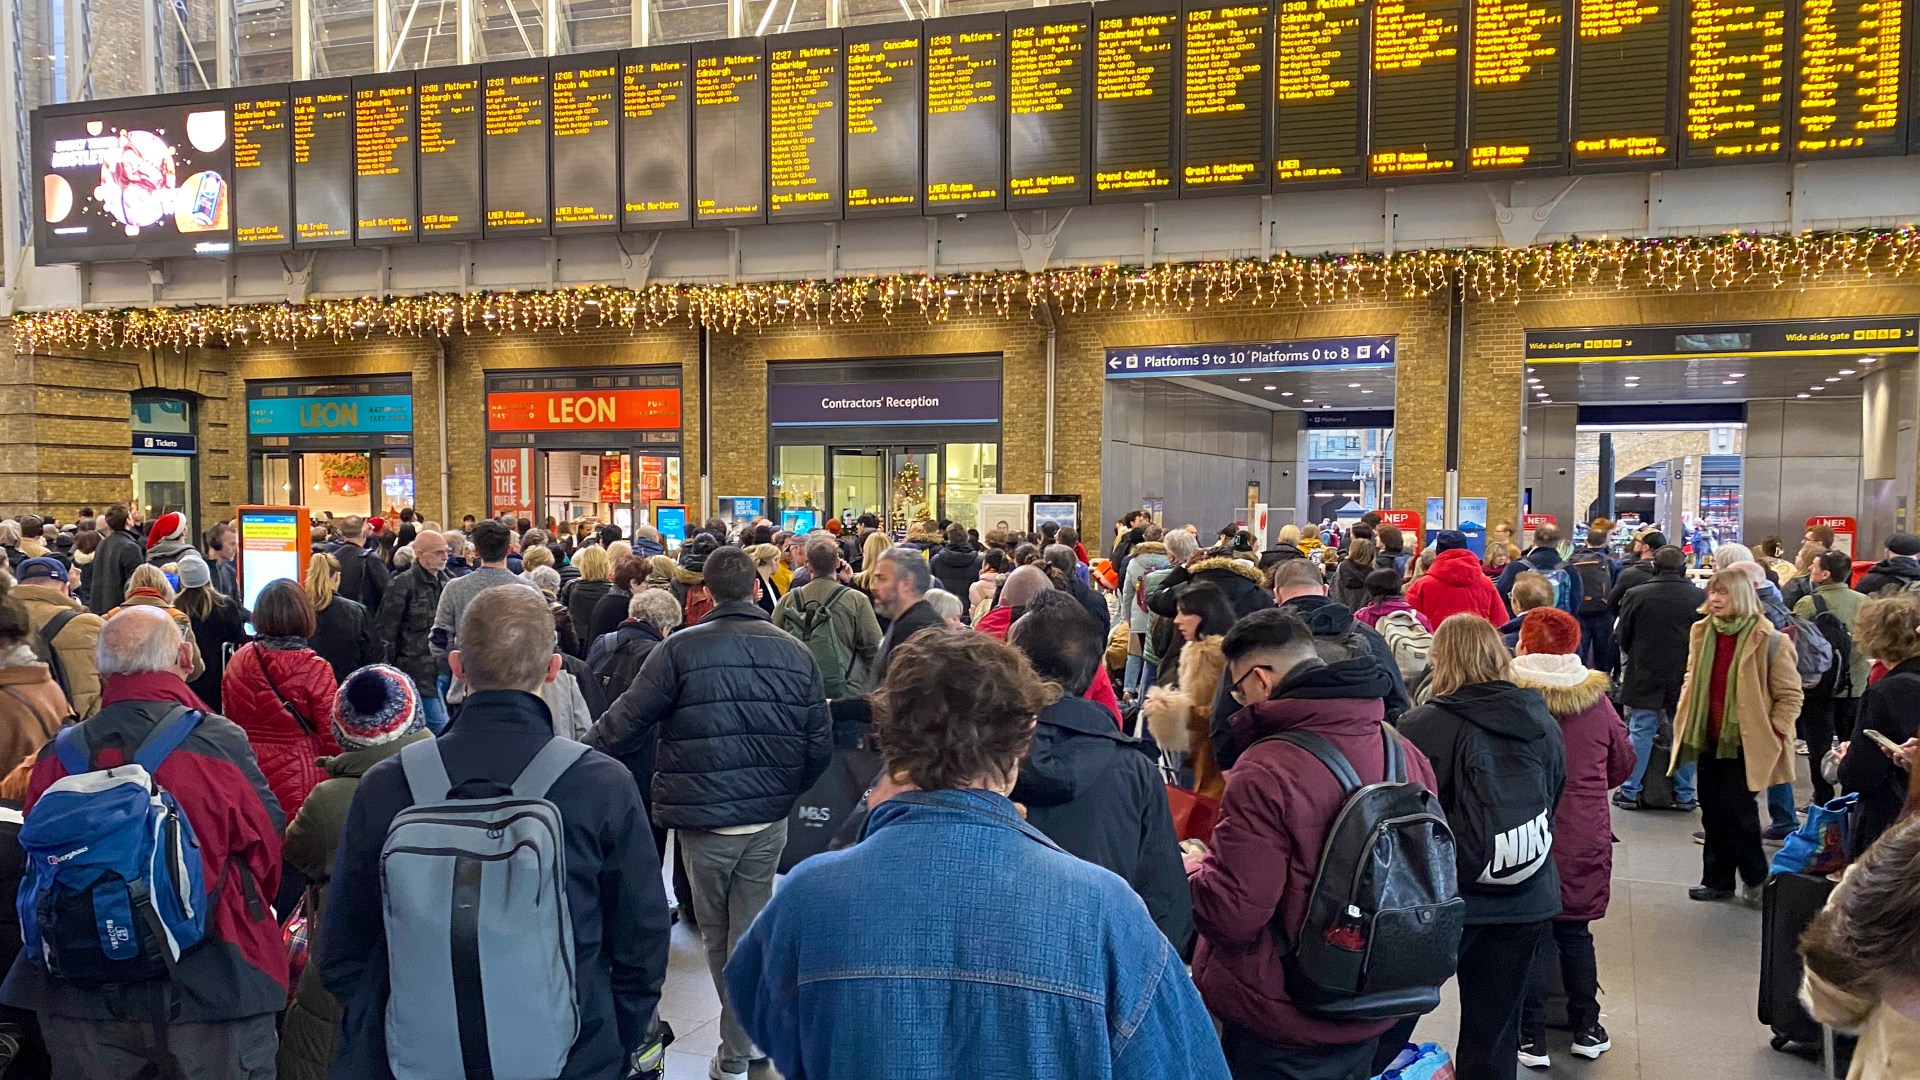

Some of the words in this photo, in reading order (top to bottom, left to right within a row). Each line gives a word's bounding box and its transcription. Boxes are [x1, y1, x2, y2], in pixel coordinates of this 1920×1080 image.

[1283, 2, 1306, 12] 13:00
[1377, 5, 1404, 15] Leeds
[1189, 11, 1212, 21] 12:57
[1222, 8, 1258, 18] Platform
[1281, 12, 1324, 23] Edinburgh
[1132, 16, 1167, 27] Platform
[1188, 20, 1237, 32] Letchworth
[1013, 28, 1034, 37] 12:42
[1043, 24, 1078, 35] Platform
[1099, 28, 1144, 40] Sunderland
[1147, 27, 1159, 36] via
[930, 36, 951, 46] 12:33
[960, 33, 993, 43] Platform
[1012, 40, 1032, 49] Kings
[1036, 37, 1055, 46] Lynn
[849, 44, 869, 53] 12:30
[883, 39, 918, 50] Cancelled
[772, 50, 792, 60] 12:27
[800, 48, 830, 58] Platform
[929, 48, 952, 56] Leeds
[724, 56, 753, 65] Platform
[848, 53, 885, 64] Edinburgh
[625, 65, 644, 74] 12:12
[651, 63, 680, 72] Platform
[772, 61, 807, 70] Cambridge
[580, 69, 607, 78] Platform
[696, 67, 731, 78] Edinburgh
[487, 78, 504, 87] 12:03
[511, 76, 538, 84] Platform
[624, 75, 634, 84] Ely
[421, 85, 438, 93] 12:00
[445, 82, 471, 90] Platform
[554, 81, 576, 90] Lincoln
[379, 88, 406, 97] Platform
[486, 88, 505, 96] Leeds
[256, 100, 280, 108] Platform
[317, 94, 342, 103] Platform
[356, 99, 391, 108] Letchworth
[421, 94, 450, 103] Edinburgh
[234, 111, 265, 119] Sunderland
[1576, 140, 1605, 151] Great
[1610, 138, 1656, 148] Northern
[1473, 147, 1497, 157] LNER
[1500, 146, 1529, 155] Azuma
[1374, 153, 1396, 163] LNER
[1399, 153, 1427, 161] Azuma
[1186, 166, 1210, 176] Great
[1214, 163, 1254, 174] Northern
[1278, 160, 1299, 169] LNER
[1097, 172, 1121, 181] Grand
[1124, 170, 1155, 179] Central
[1011, 178, 1034, 188] Great
[1037, 175, 1074, 186] Northern
[849, 189, 867, 198] LNER
[929, 184, 947, 193] LNER
[950, 183, 973, 192] Azuma
[772, 194, 792, 203] Great
[795, 192, 829, 201] Northern
[626, 203, 645, 212] Great
[648, 201, 679, 210] Northern
[378, 218, 406, 226] Northern
[257, 226, 277, 234] Central
[1786, 332, 1807, 342] Wide
[1808, 332, 1829, 341] aisle
[1831, 331, 1850, 343] gate
[1564, 341, 1581, 351] gate
[1144, 355, 1199, 368] Platforms
[1202, 354, 1210, 365] 9
[1213, 354, 1226, 365] to
[1230, 352, 1244, 364] 10
[1251, 350, 1308, 363] Platforms
[1312, 349, 1320, 360] 0
[1323, 349, 1337, 360] to
[1340, 347, 1349, 359] 8
[886, 395, 939, 409] Reception
[301, 403, 358, 427] LEON
[548, 396, 616, 423] LEON
[156, 439, 177, 447] Tickets
[494, 459, 516, 474] SKIP
[1675, 470, 1682, 479] 8
[494, 475, 516, 493] THE
[495, 495, 516, 506] QUEUE
